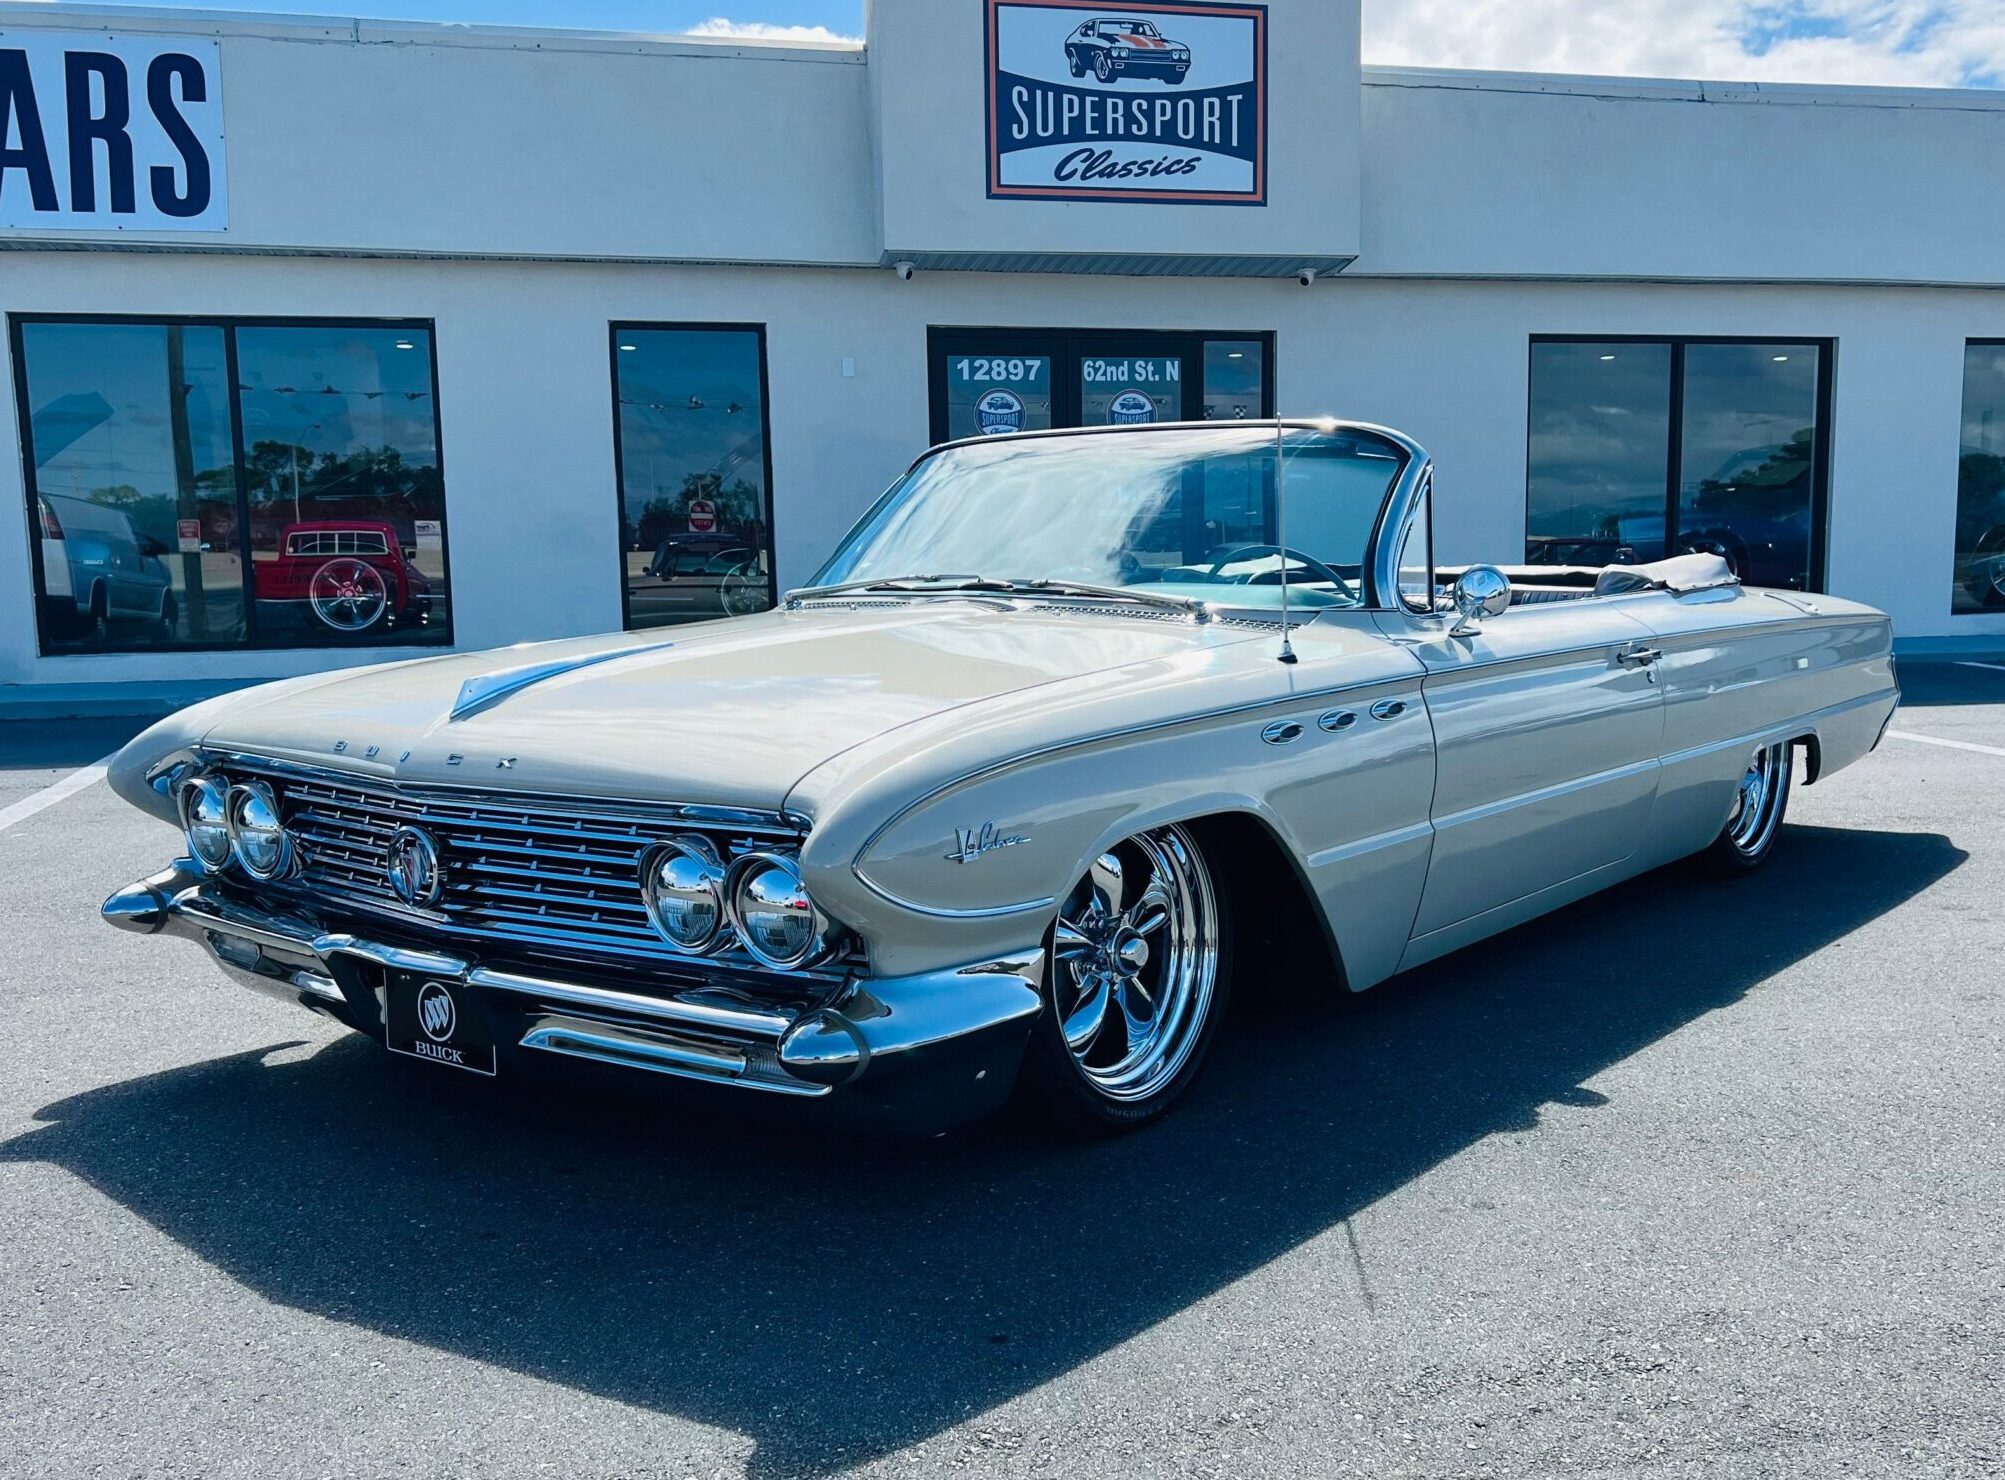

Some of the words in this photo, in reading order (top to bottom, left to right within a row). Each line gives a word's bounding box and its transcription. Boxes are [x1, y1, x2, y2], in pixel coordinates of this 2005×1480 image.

[1012, 85, 1243, 147] SUPERSPORT
[0, 49, 211, 217] ARS
[1054, 148, 1201, 182] Classics
[957, 359, 1041, 381] 12897
[1083, 360, 1128, 381] 62nd
[1134, 360, 1159, 381] St.
[1165, 360, 1179, 381] N
[982, 412, 1019, 426] SUPERSPORT
[334, 740, 518, 769] BUICK
[415, 1040, 464, 1064] BUICK
